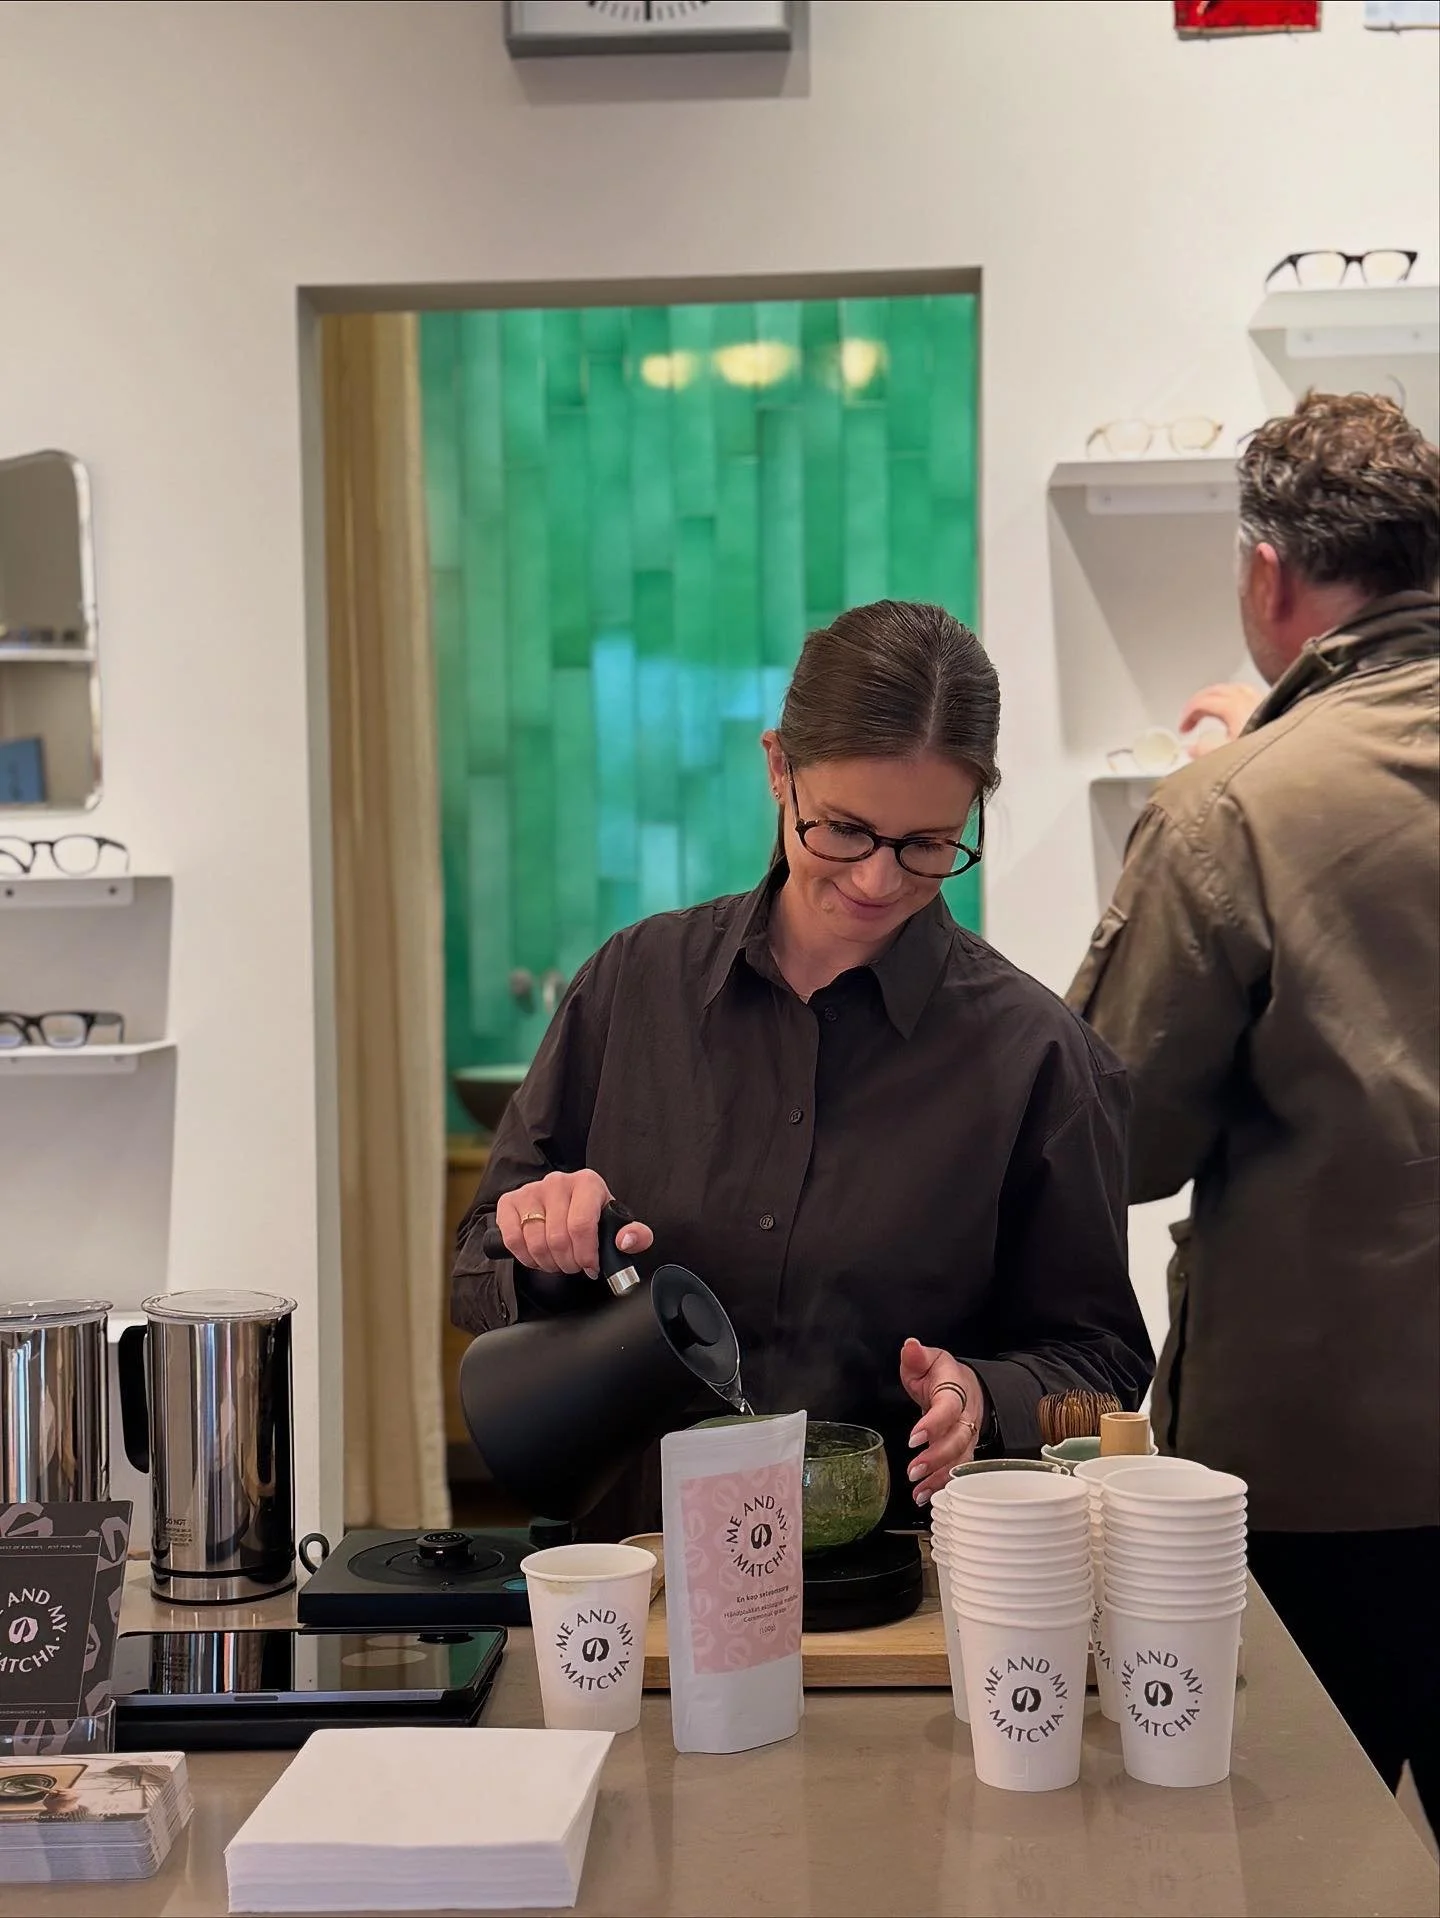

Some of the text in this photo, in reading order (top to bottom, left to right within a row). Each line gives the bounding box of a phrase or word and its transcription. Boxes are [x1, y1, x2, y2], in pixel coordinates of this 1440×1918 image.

[726, 1495, 788, 1544] ME AND MY
[732, 1544, 787, 1577] MATCHA
[8, 1588, 68, 1633] AND MY
[556, 1609, 633, 1651] ME AND MY
[0, 1644, 60, 1673] ATCHA
[561, 1660, 630, 1690] MATCHA
[1121, 1660, 1135, 1691] ME
[1136, 1650, 1179, 1668] AND
[1179, 1668, 1203, 1695] MY
[984, 1656, 1068, 1700] ME AND MY
[989, 1709, 1064, 1743] MATCHA
[1127, 1703, 1201, 1737] MATCHA
